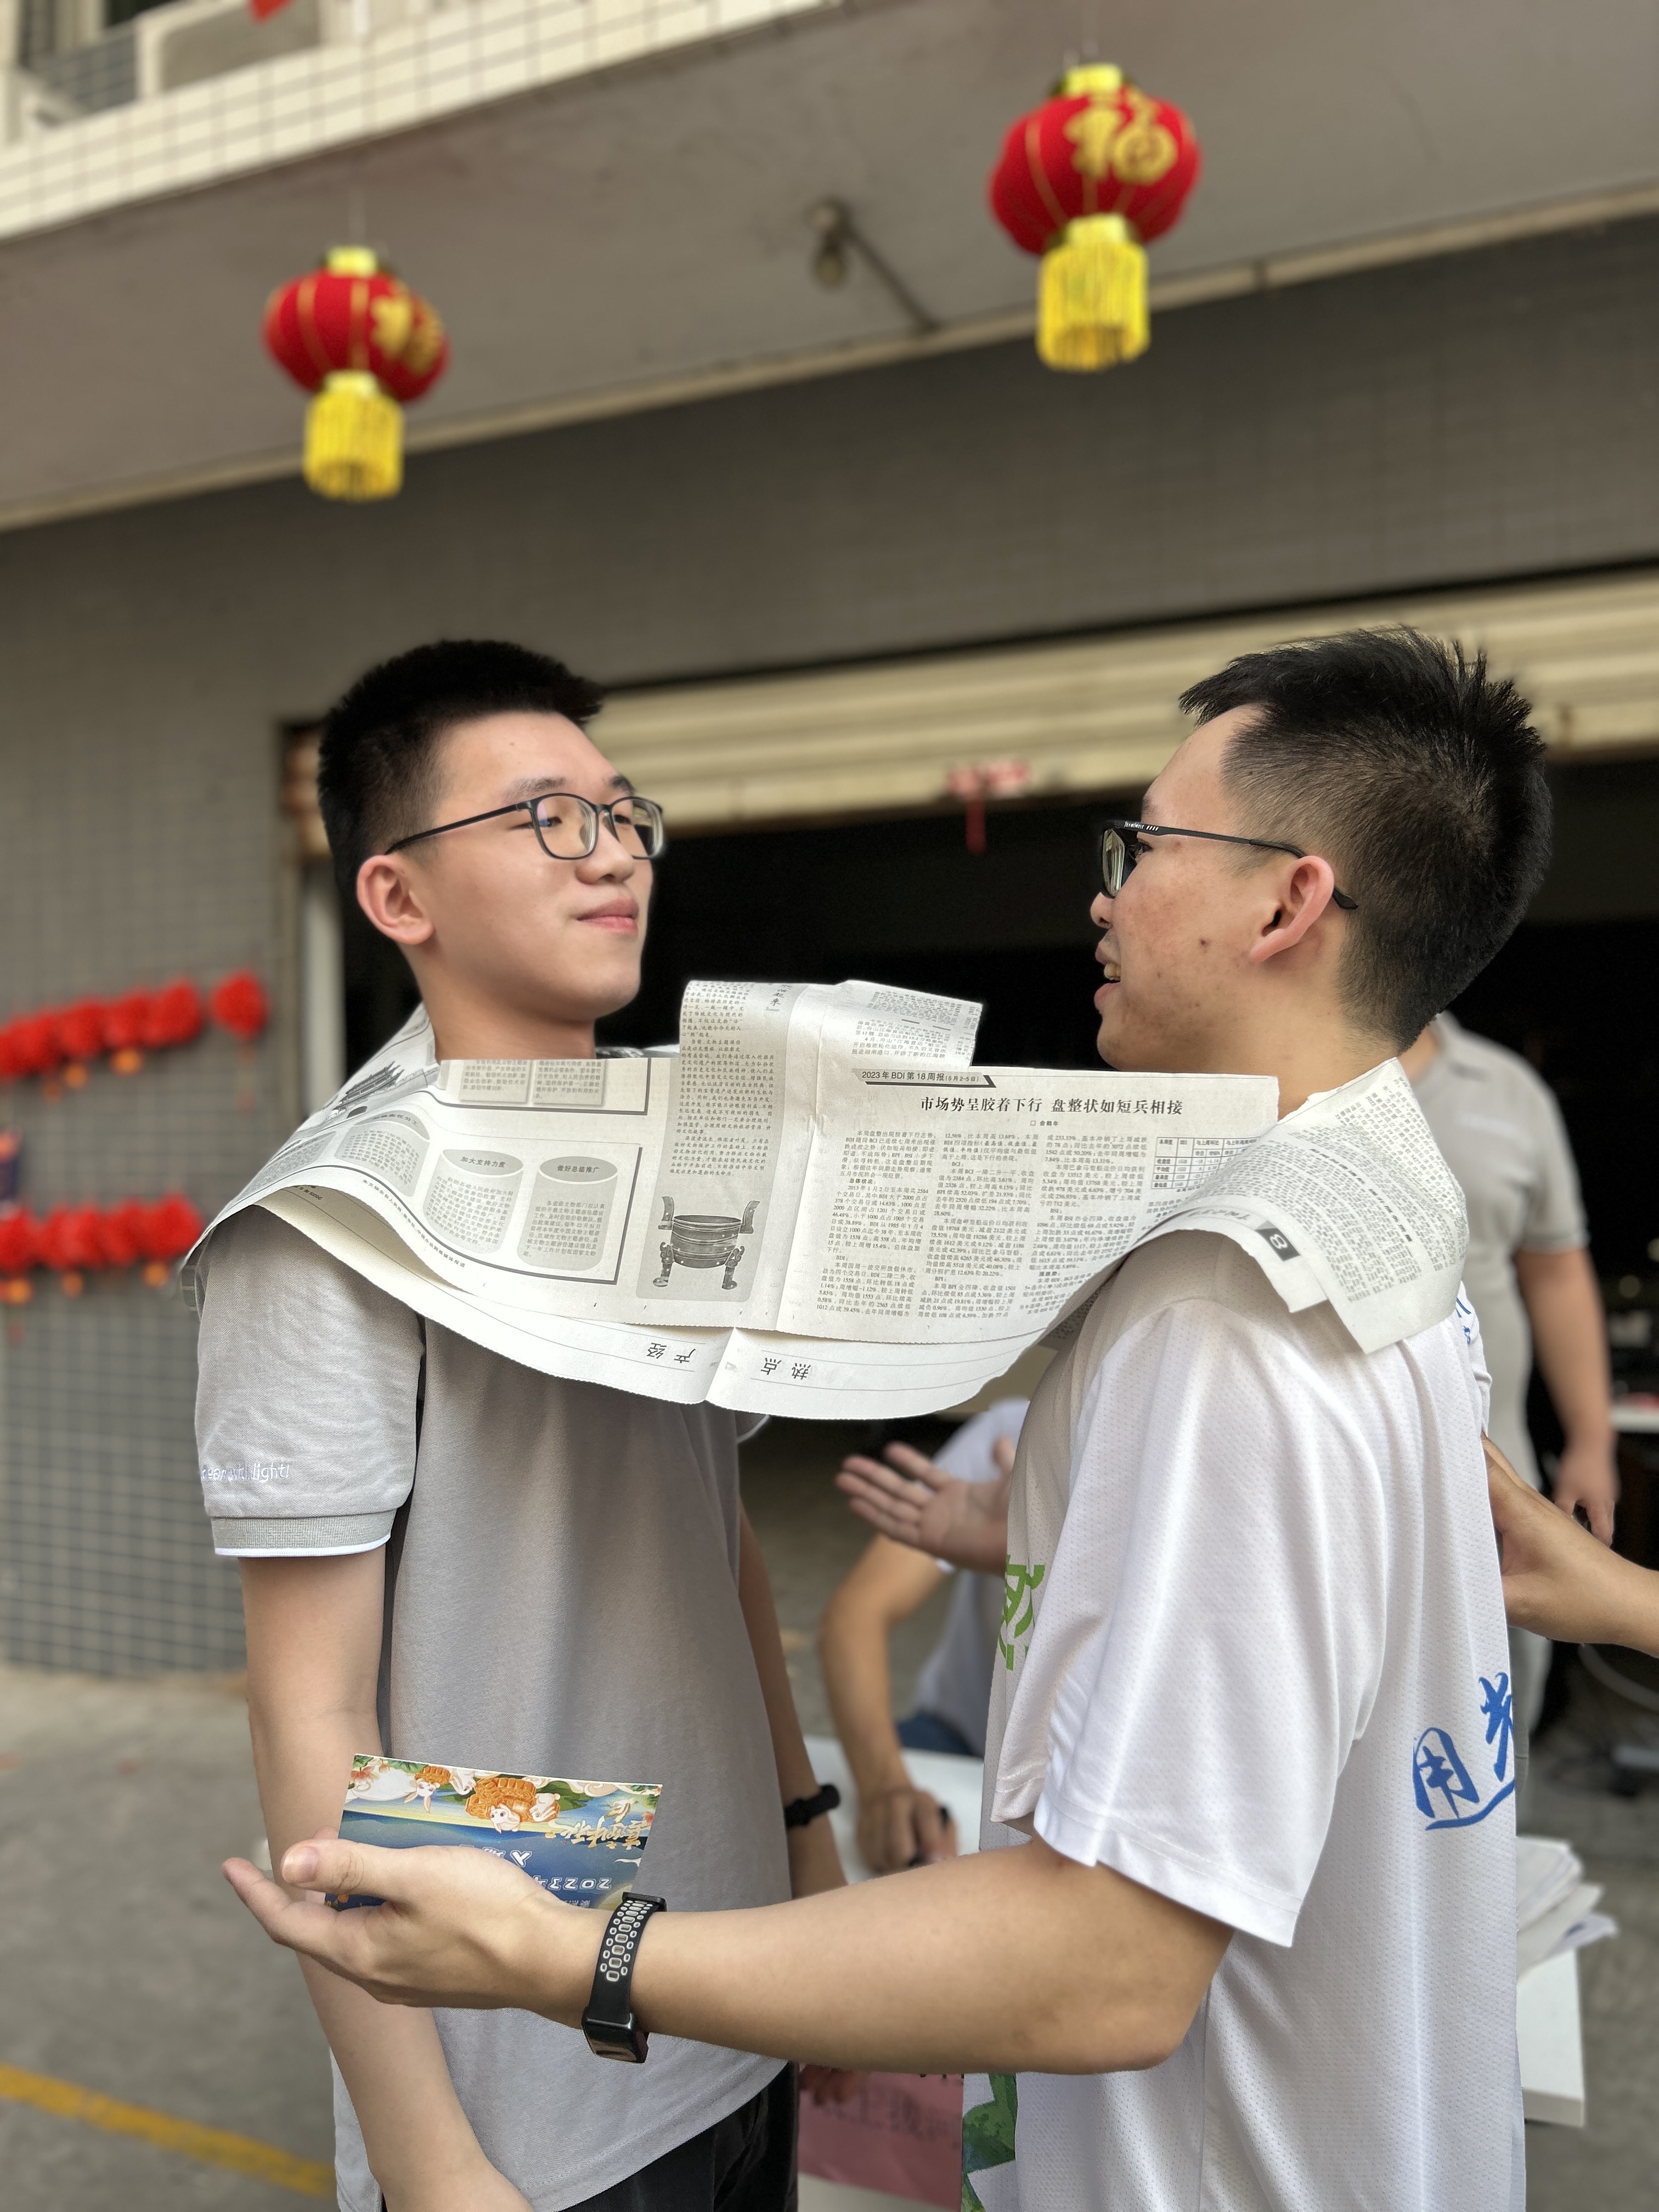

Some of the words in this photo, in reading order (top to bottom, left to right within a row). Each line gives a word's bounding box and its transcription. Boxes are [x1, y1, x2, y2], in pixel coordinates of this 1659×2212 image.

[920, 1097, 1042, 1113] 市场势呈胶着下行
[1052, 1098, 1183, 1115] 盘整状如短兵相接
